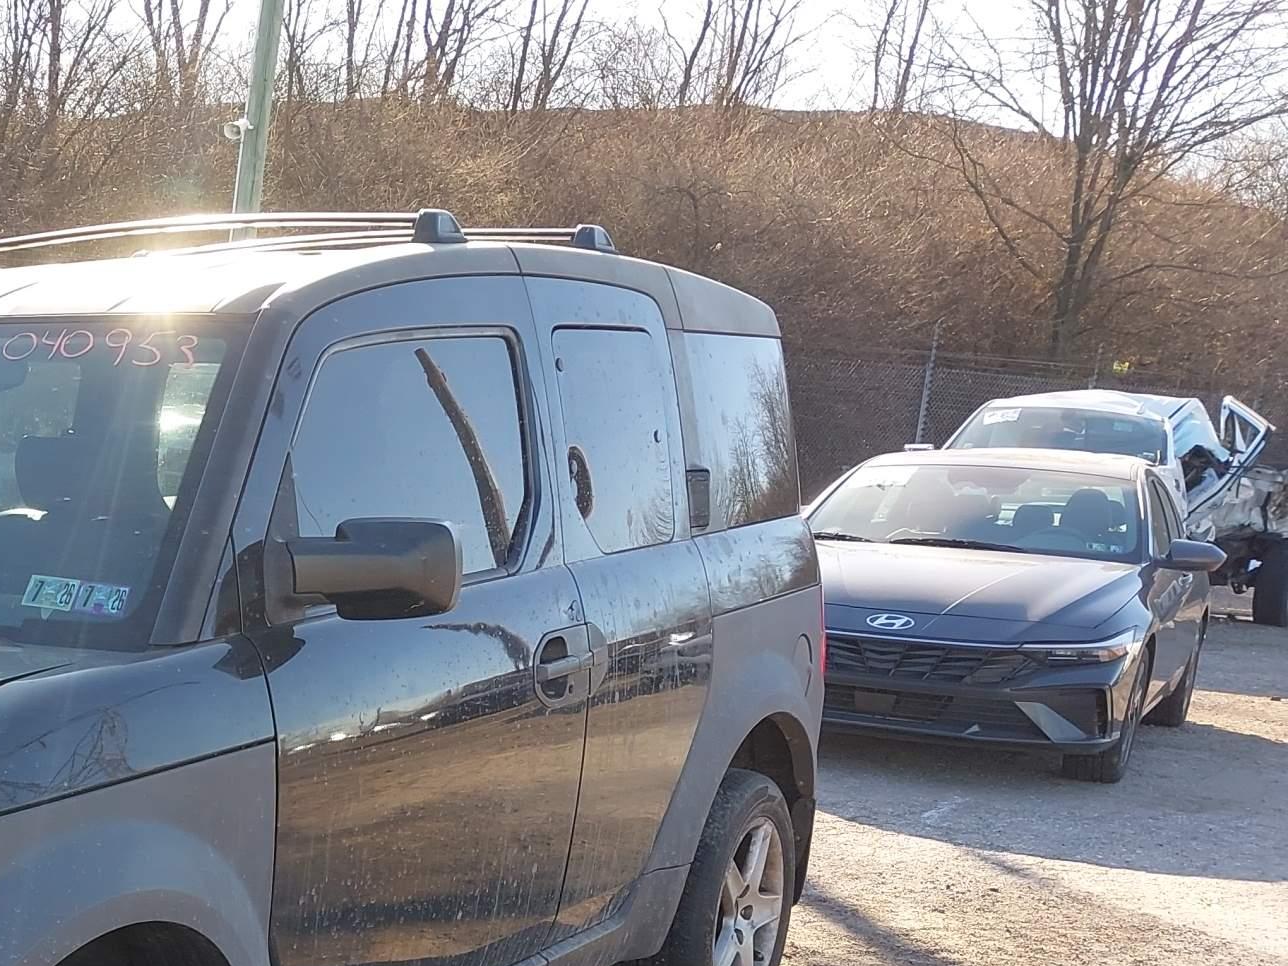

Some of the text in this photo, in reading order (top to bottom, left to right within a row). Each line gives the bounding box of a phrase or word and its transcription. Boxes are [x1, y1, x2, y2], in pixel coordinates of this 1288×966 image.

[31, 580, 76, 605] 7 26
[82, 585, 97, 608] 7
